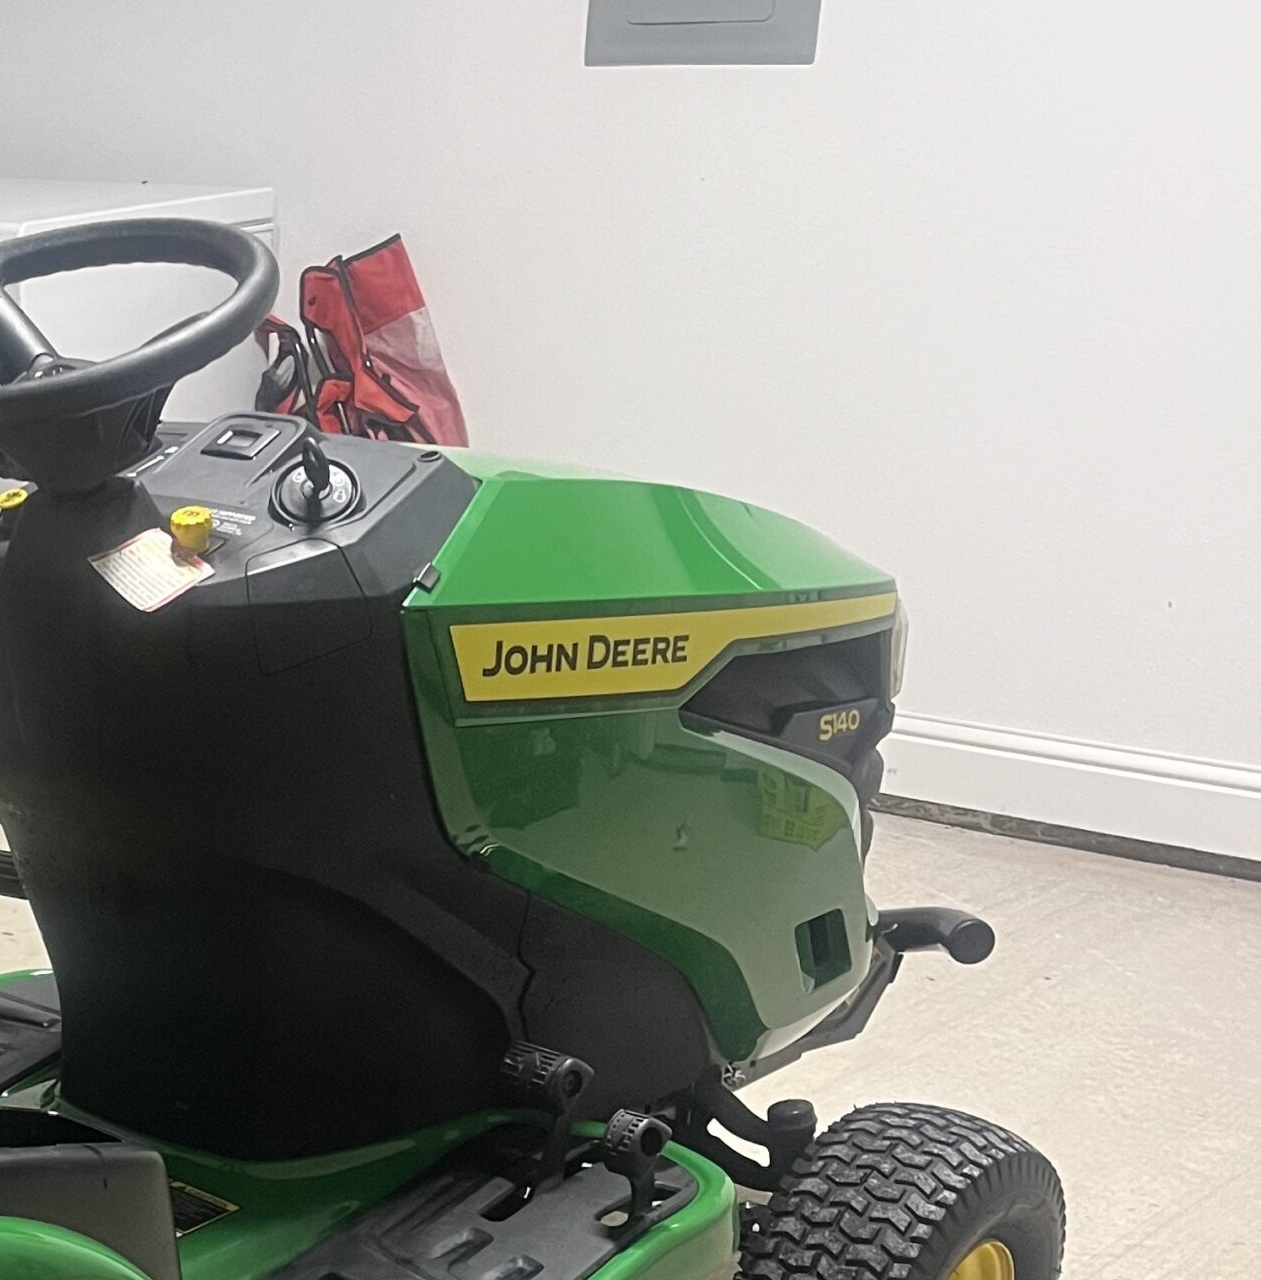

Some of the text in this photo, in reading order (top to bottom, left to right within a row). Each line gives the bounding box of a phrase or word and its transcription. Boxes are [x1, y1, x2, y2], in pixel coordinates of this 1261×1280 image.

[482, 635, 690, 677] JOHN DEERE
[819, 708, 860, 741] S140
